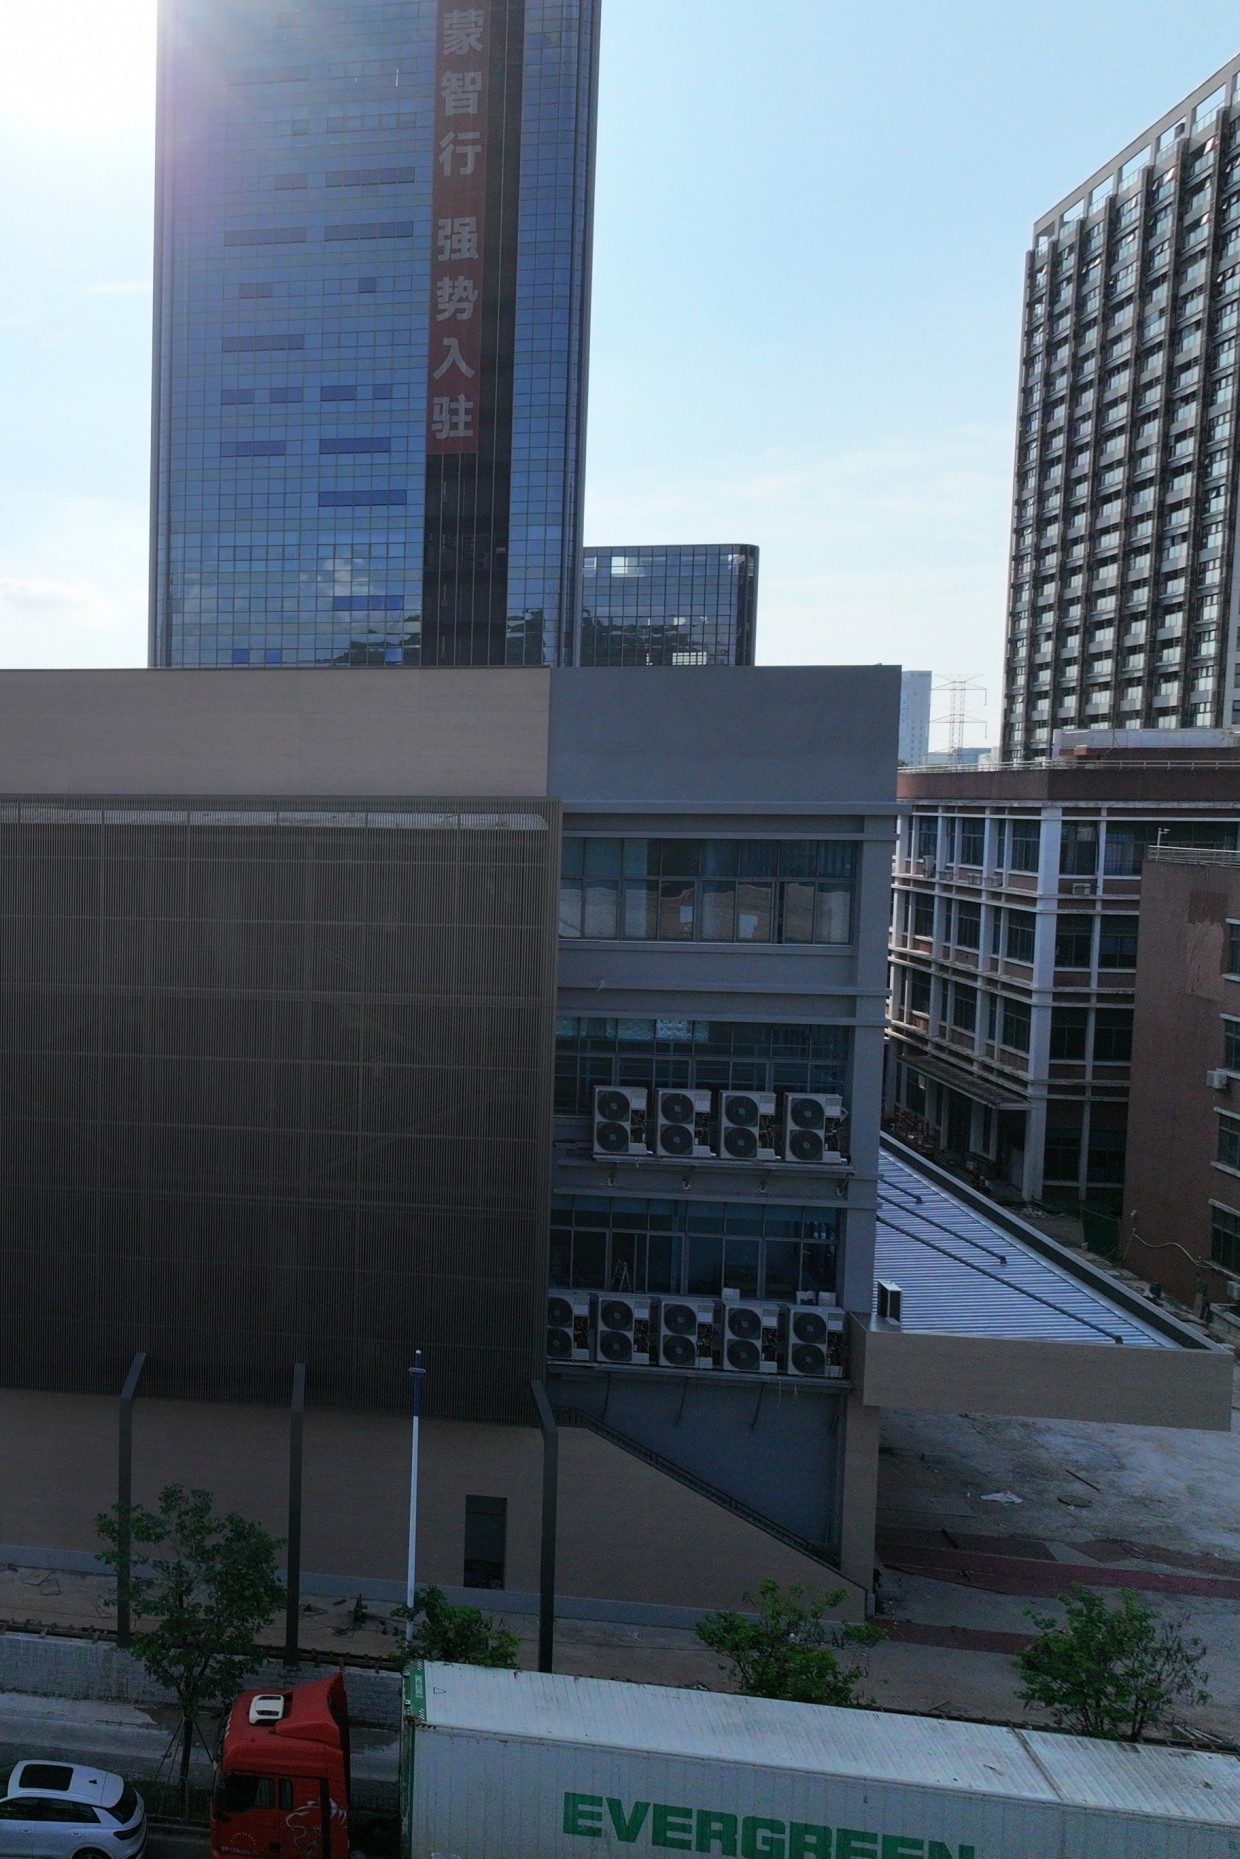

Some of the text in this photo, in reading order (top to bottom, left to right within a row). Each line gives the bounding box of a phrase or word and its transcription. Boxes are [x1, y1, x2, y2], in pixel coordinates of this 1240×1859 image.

[431, 9, 484, 440] 蒙智行 强势入驻
